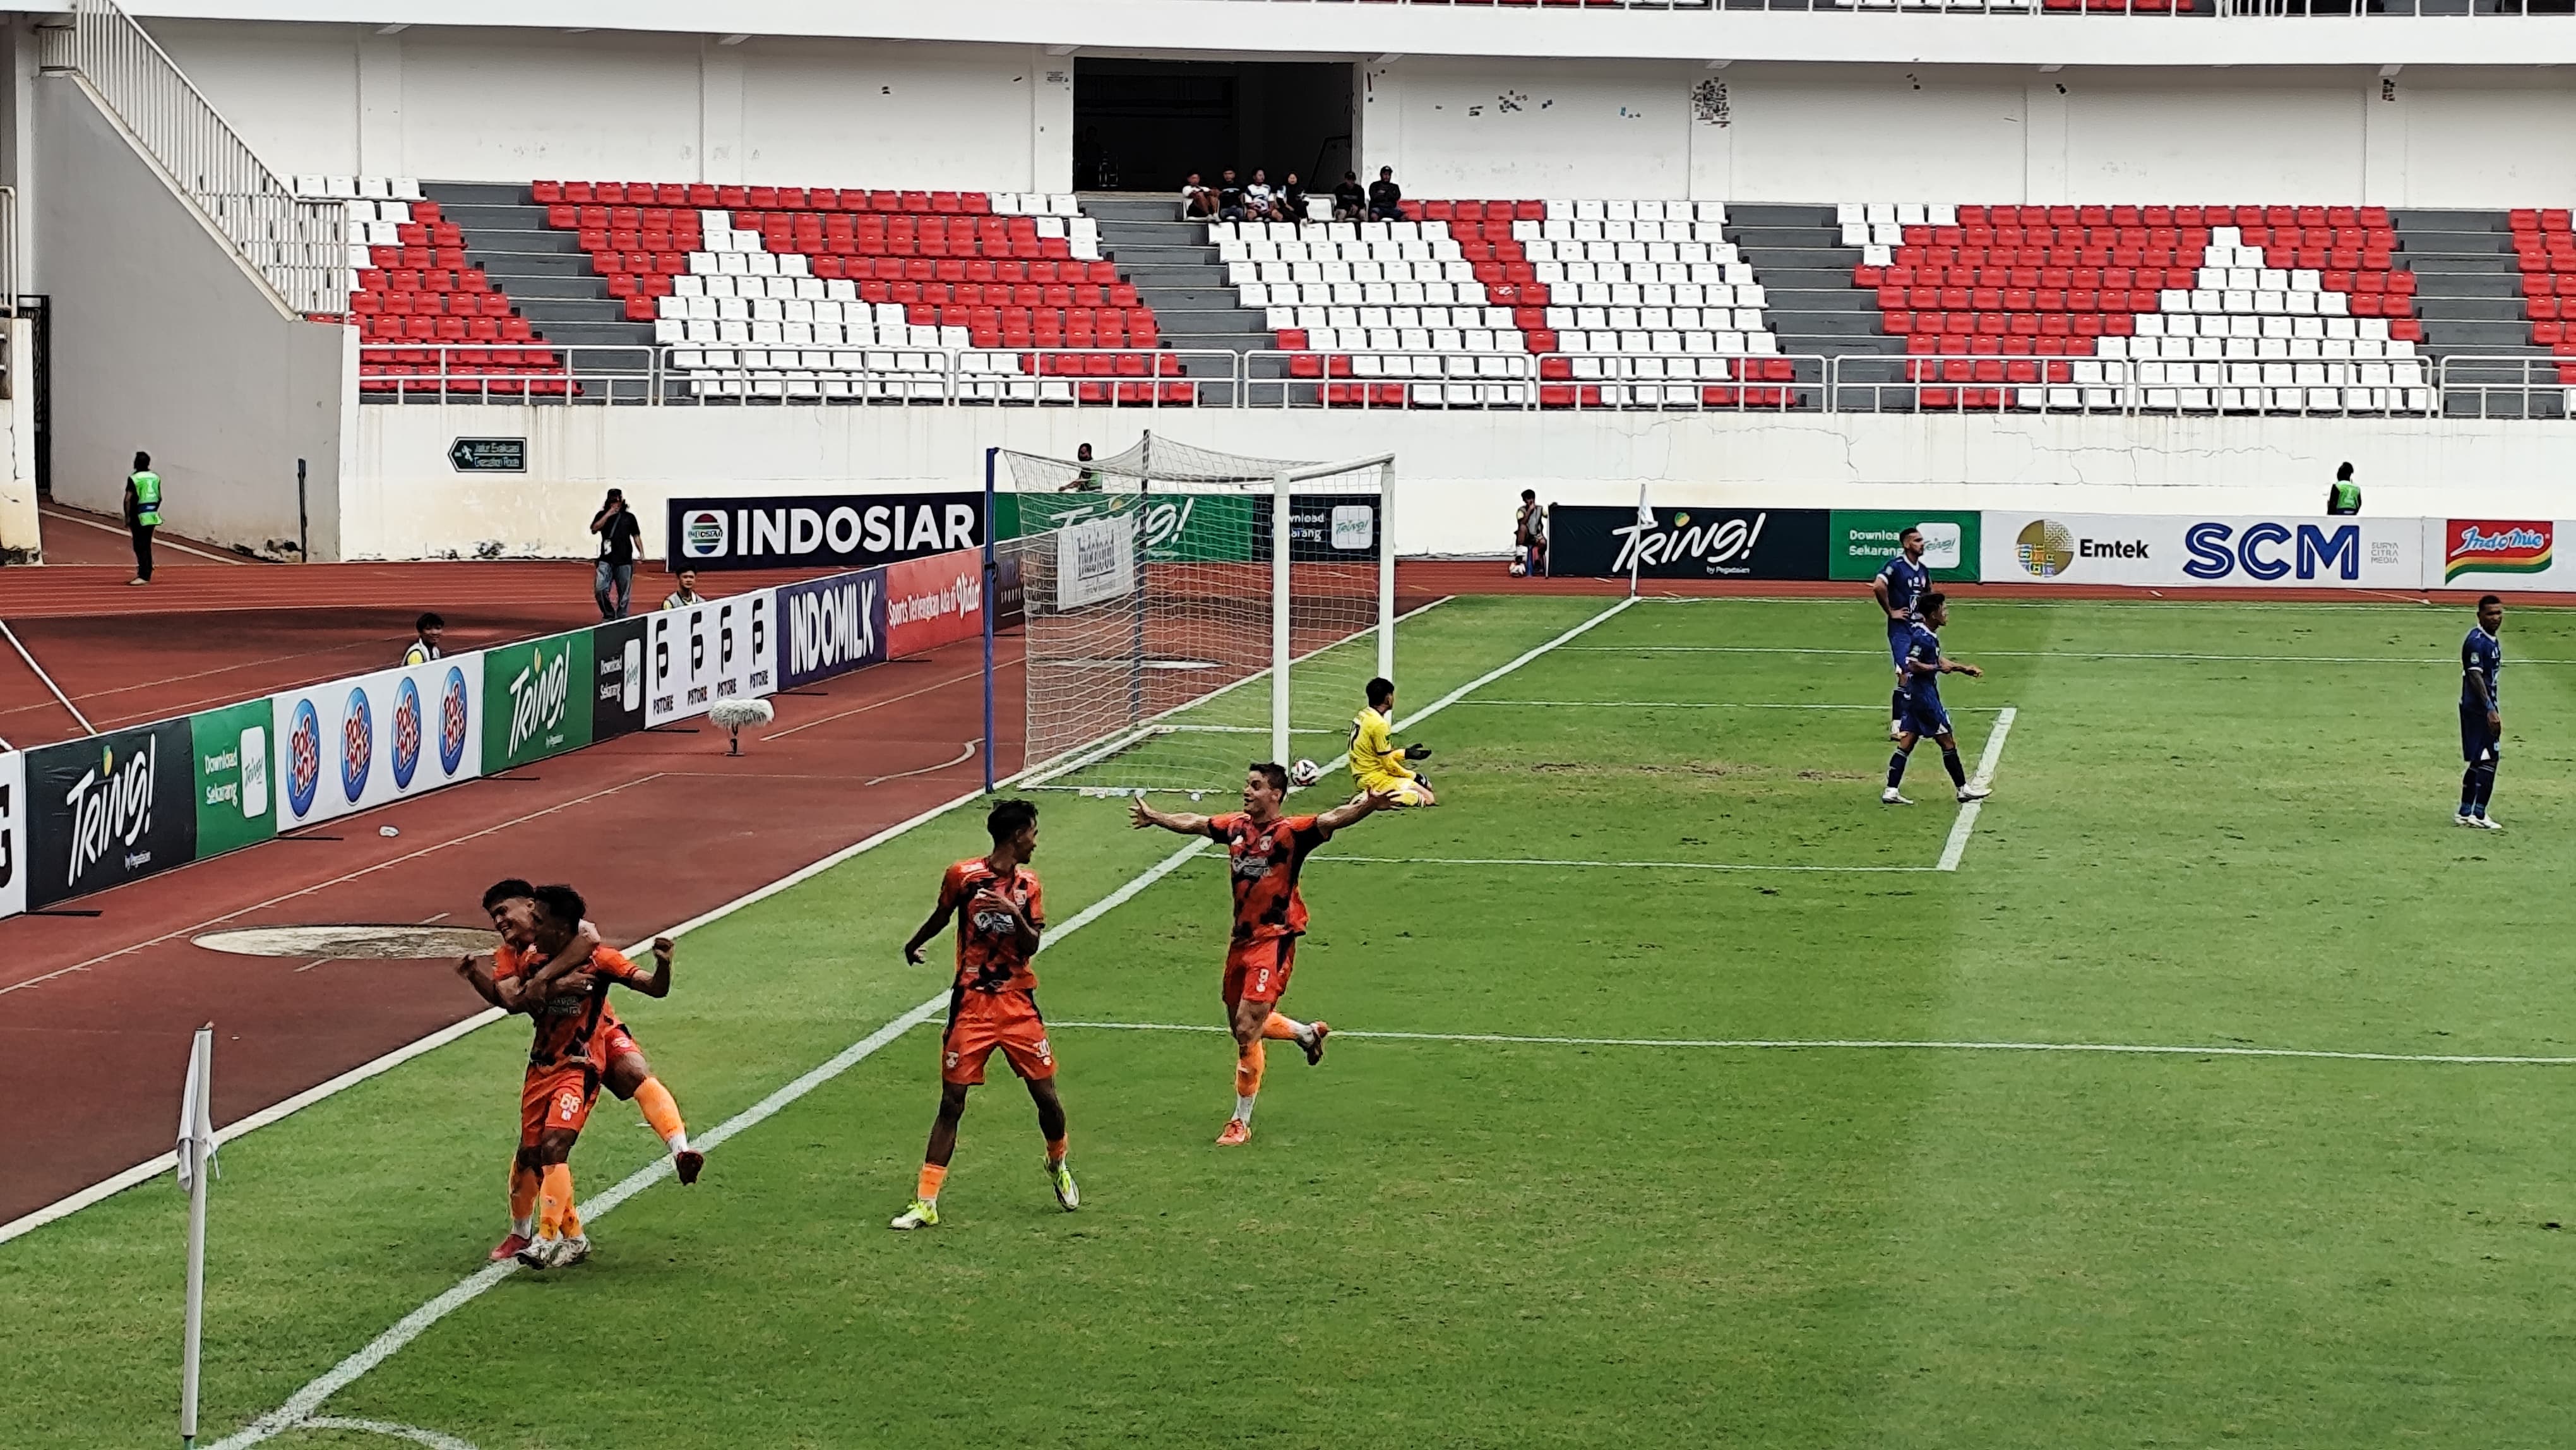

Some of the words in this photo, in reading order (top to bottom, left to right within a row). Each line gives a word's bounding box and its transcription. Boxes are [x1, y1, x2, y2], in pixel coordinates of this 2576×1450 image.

[737, 505, 975, 556] INDOSIAR
[1850, 530, 1900, 541] Downloa
[2080, 539, 2150, 558] Emtek
[2183, 522, 2360, 580] SCM
[790, 578, 875, 676] INDOMILK
[888, 599, 908, 630] Sports
[688, 685, 707, 707] PSTORE
[717, 678, 737, 698] PSTORE
[749, 669, 768, 691] PSTORE
[397, 693, 412, 748] POP
[444, 683, 460, 735] POP
[653, 694, 674, 716] PSTORE
[291, 714, 311, 772] POP
[345, 704, 363, 760] POP
